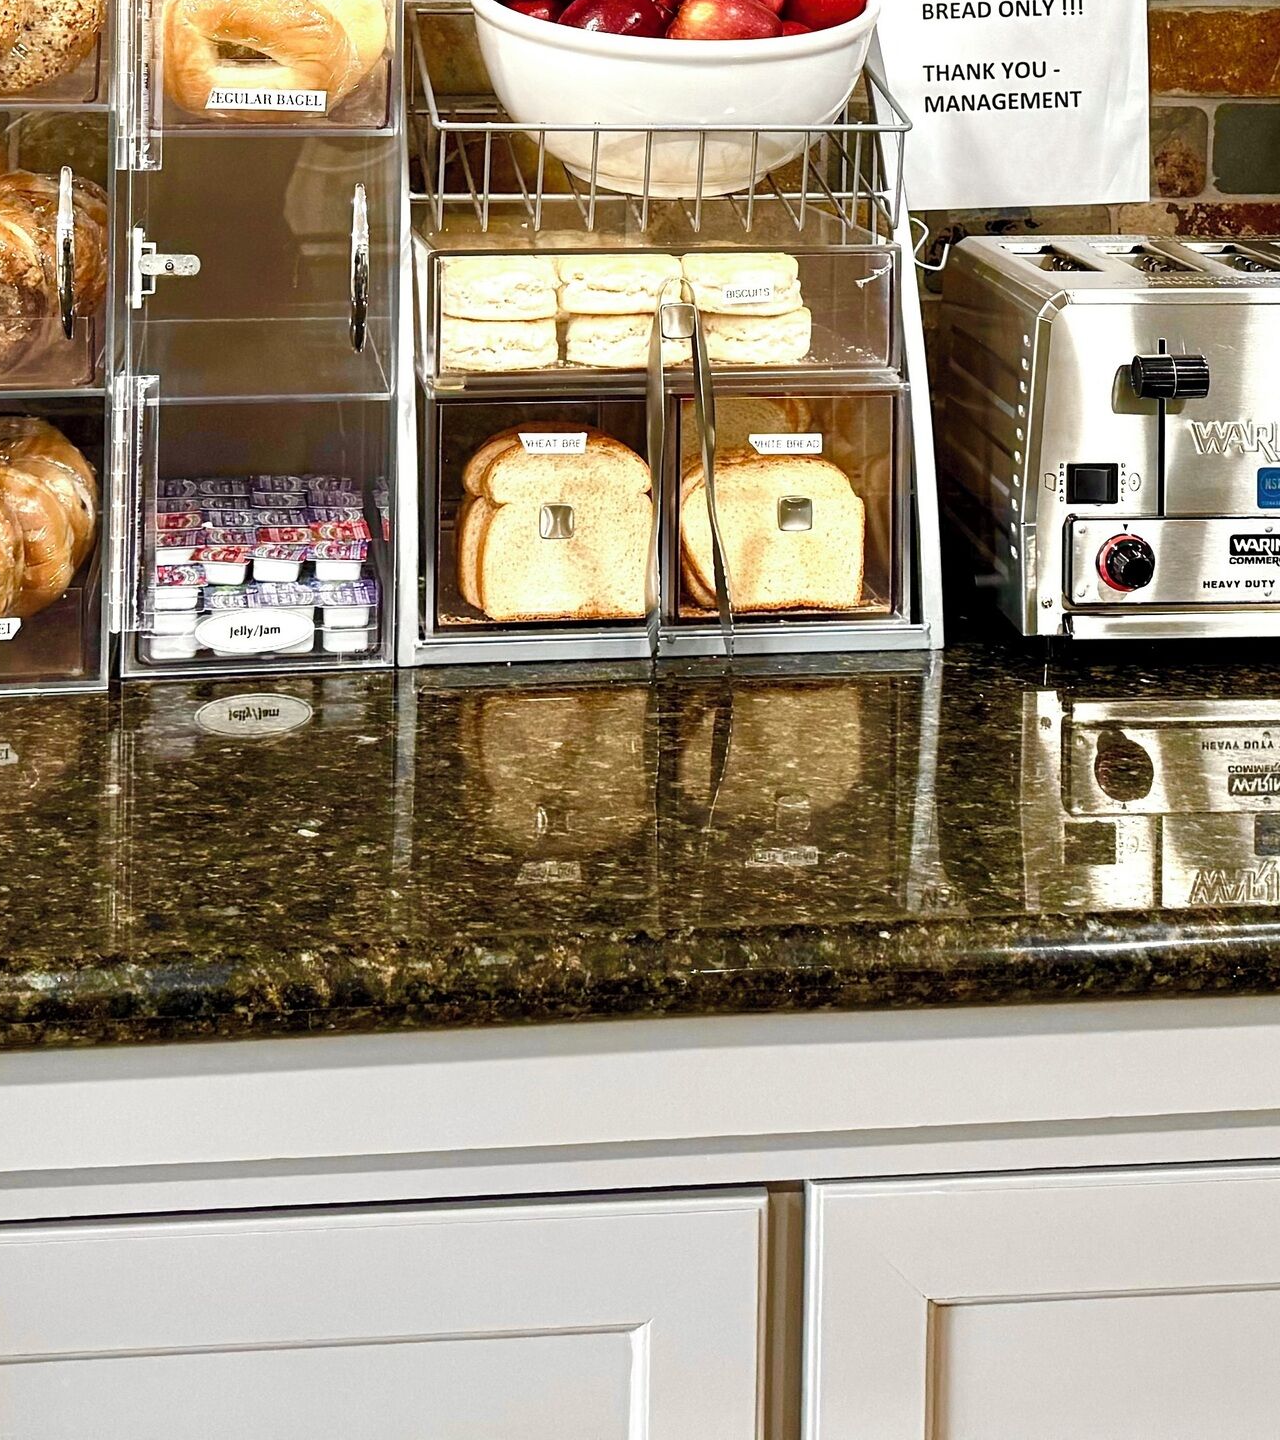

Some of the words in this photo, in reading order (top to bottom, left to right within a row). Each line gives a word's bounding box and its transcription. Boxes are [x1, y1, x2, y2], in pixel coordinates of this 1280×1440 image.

[922, 1, 992, 20] BREAD
[922, 62, 996, 82] THANK
[1001, 60, 1047, 80] YOU
[276, 93, 323, 107] BAGEL
[924, 90, 1083, 114] MANAGEMENT
[725, 287, 771, 299] BISCUITS
[786, 439, 820, 449] BREAD
[1202, 579, 1241, 589] HEAVY
[1244, 579, 1276, 588] DUTY
[229, 624, 282, 639] Jelly/Jam
